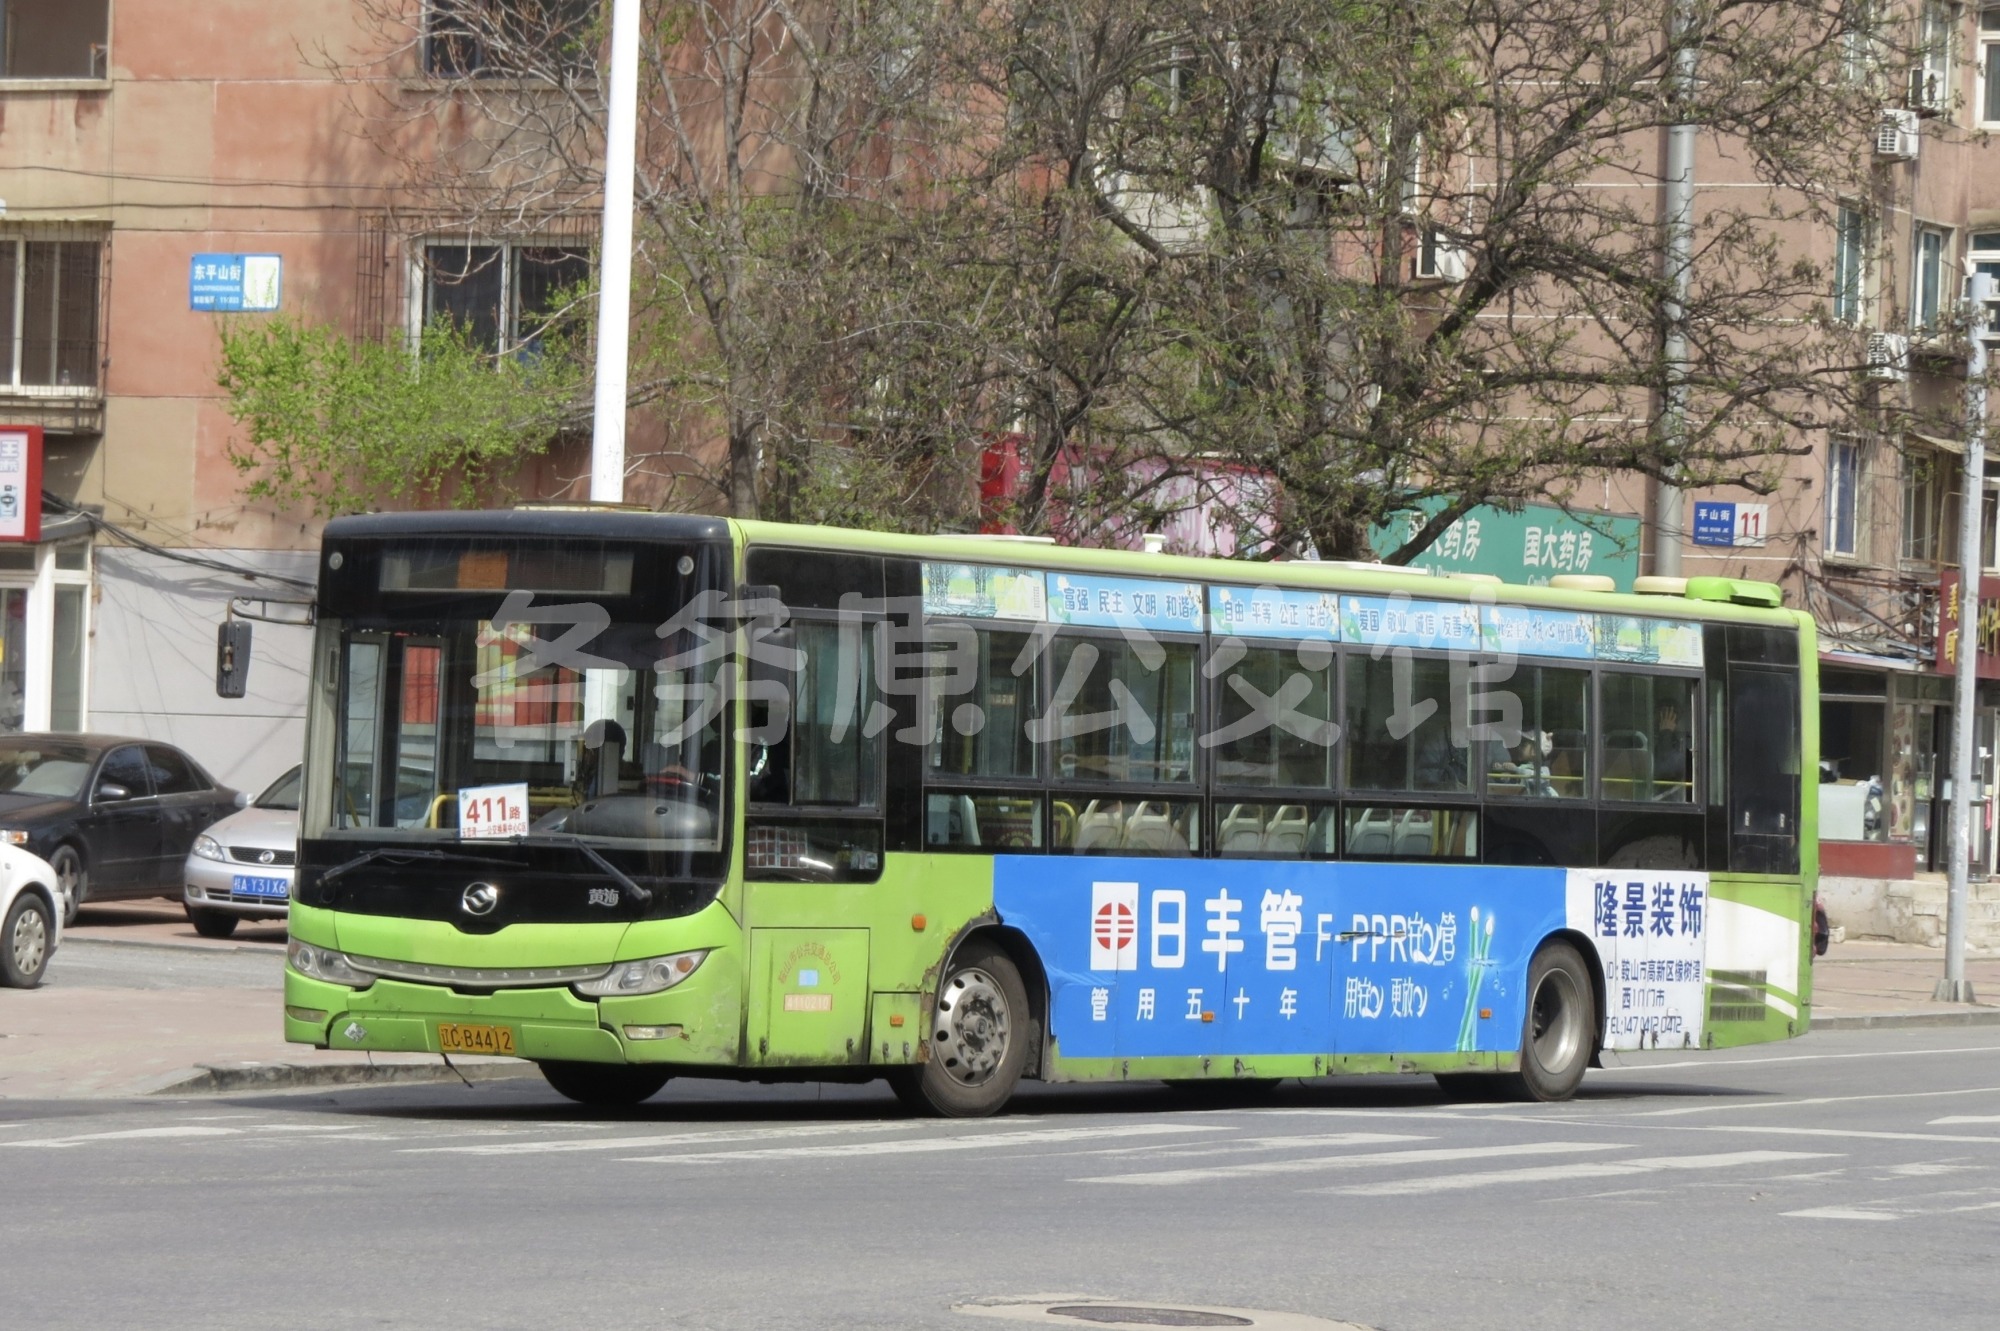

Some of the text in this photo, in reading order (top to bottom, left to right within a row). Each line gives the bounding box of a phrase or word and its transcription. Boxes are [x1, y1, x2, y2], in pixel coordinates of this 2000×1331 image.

[194, 263, 241, 281] 东平山街
[1698, 508, 1759, 537] 平山街 11
[1523, 526, 1593, 572] 国大药房
[1063, 587, 1089, 612] 富强
[1099, 590, 1123, 613] 民主
[1132, 592, 1157, 616] 文明
[1166, 595, 1190, 618] 和谐
[1224, 600, 1327, 627] 自由 平等 公正 法治
[1359, 610, 1462, 637] 爱国 敬业 诚信 友善
[466, 795, 520, 823] 411路
[588, 888, 619, 906] 黄海
[1594, 881, 1703, 938] 隆景装饰
[1151, 887, 1303, 973] 日丰管
[1091, 987, 1298, 1021] 管用五十年
